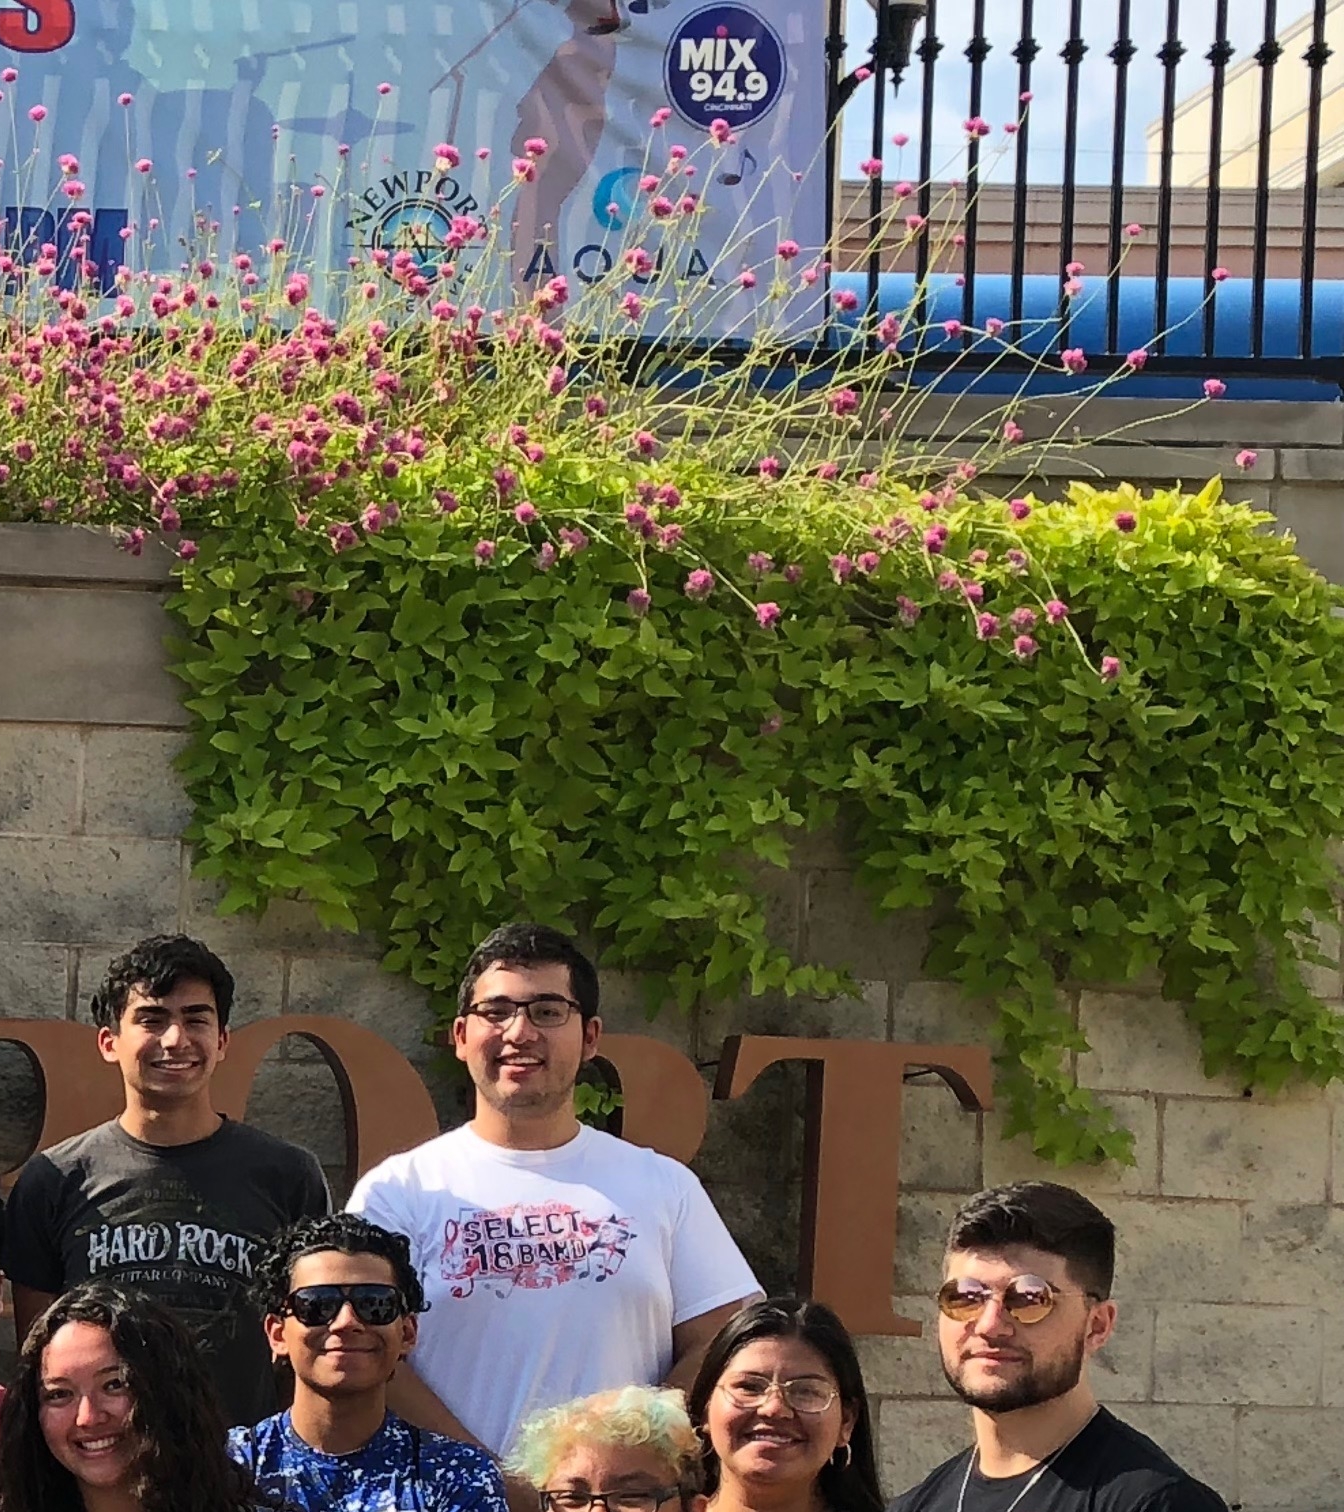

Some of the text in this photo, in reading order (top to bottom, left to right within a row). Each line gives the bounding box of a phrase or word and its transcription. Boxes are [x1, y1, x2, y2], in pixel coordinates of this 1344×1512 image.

[678, 37, 757, 71] MIX
[689, 71, 769, 102] 94.9
[463, 1210, 581, 1244] SELECT
[87, 1221, 259, 1279] HARD ROCK
[518, 1239, 588, 1266] BAND
